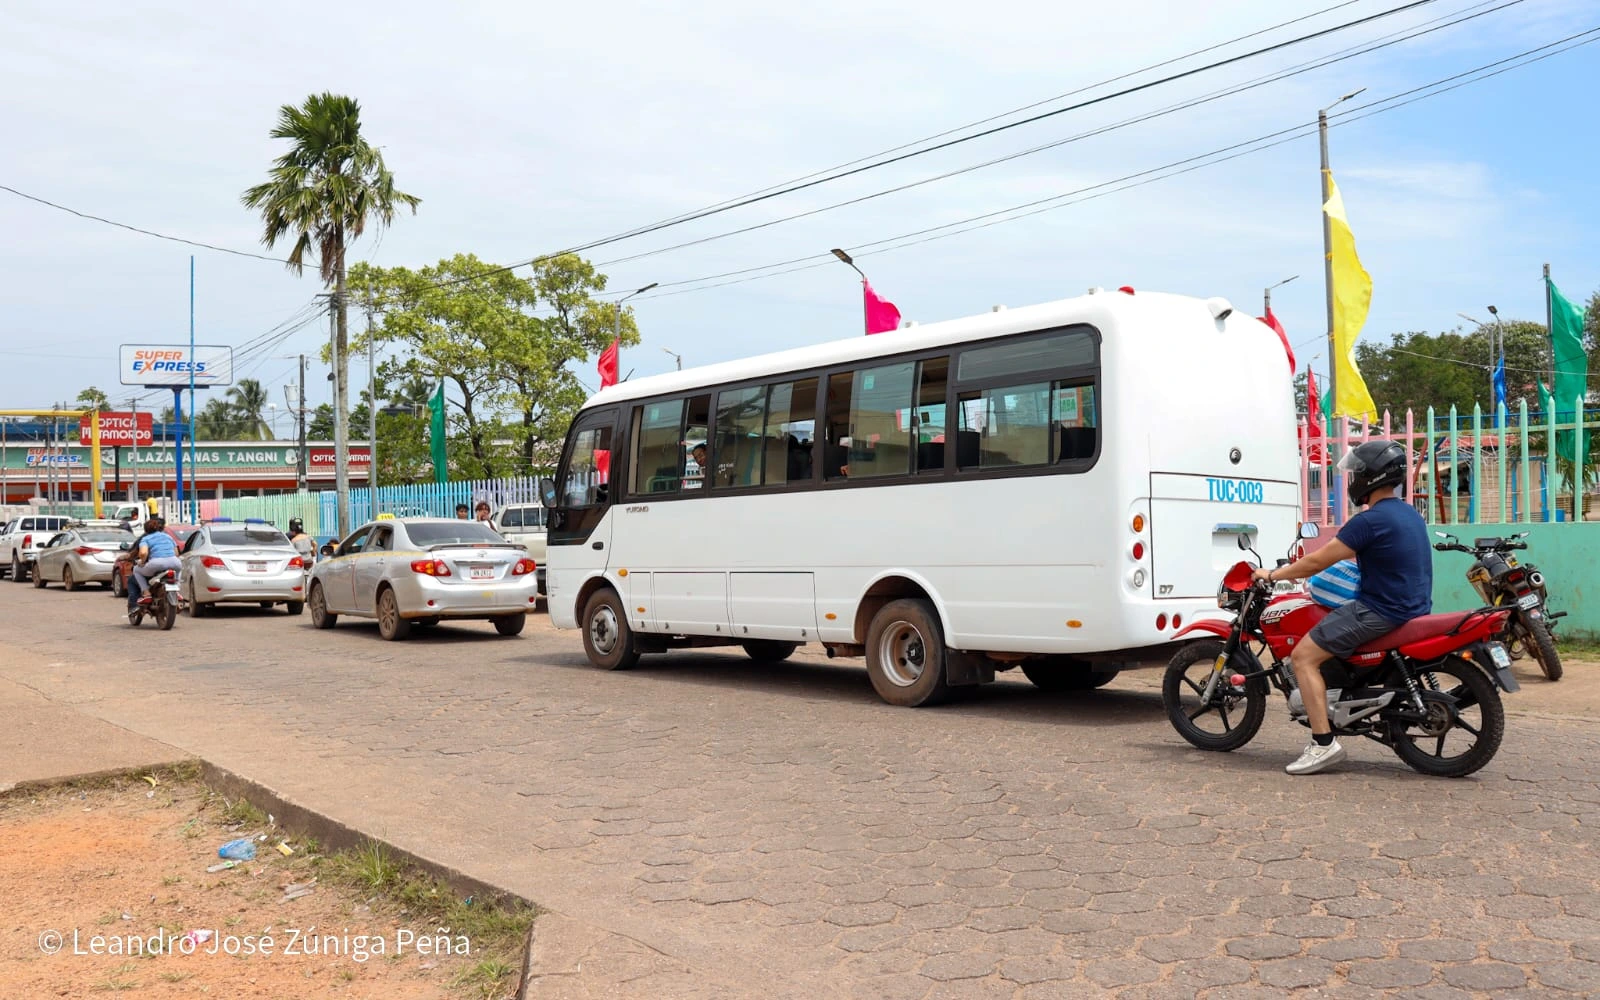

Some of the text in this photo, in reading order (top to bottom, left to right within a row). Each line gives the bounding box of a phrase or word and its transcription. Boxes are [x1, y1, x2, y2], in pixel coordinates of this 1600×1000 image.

[134, 350, 183, 360] SUPER
[132, 360, 206, 374] EXPRESS
[82, 426, 151, 439] MTAMOROS
[127, 451, 175, 463] PLAZA
[227, 451, 278, 463] TANGNI
[1159, 585, 1174, 594] D7
